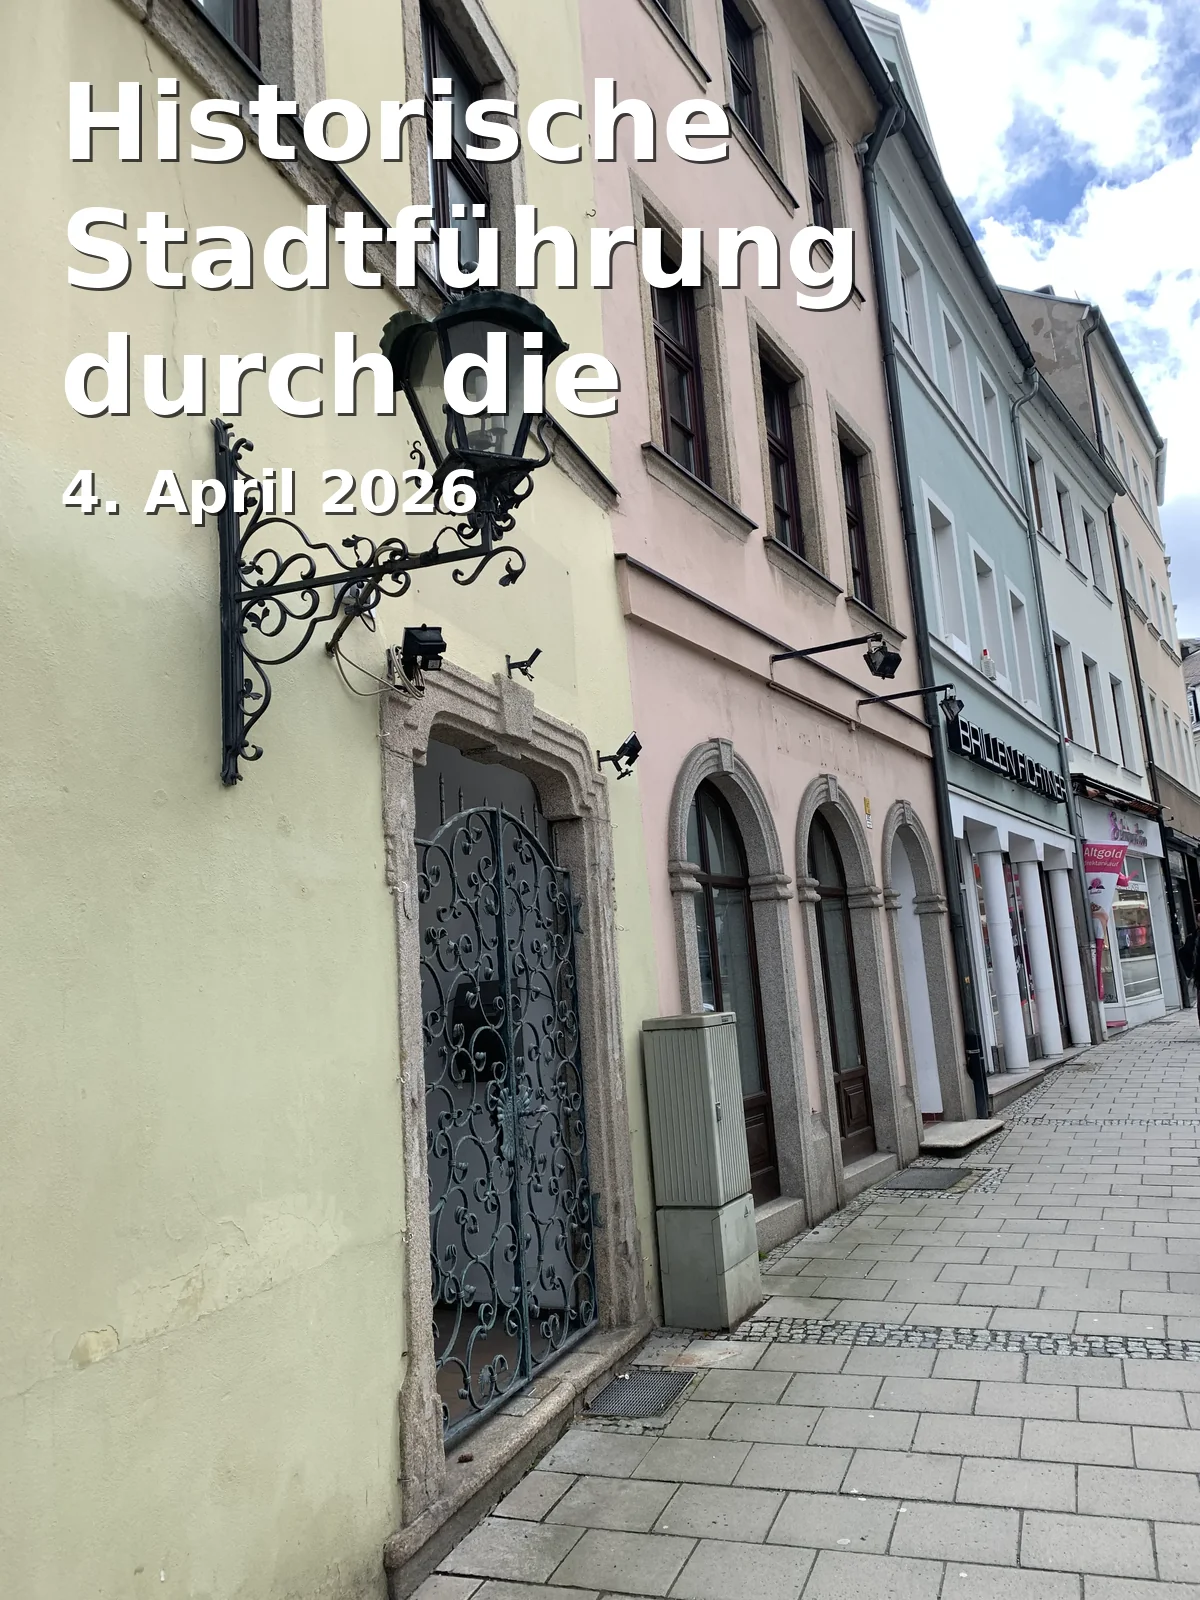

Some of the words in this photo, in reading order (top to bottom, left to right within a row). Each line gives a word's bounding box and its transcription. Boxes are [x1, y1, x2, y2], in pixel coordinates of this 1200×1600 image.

[957, 715, 1017, 777] BRILLEN
[1016, 749, 1069, 803] FICHTNER
[1084, 847, 1123, 860] Altgold
